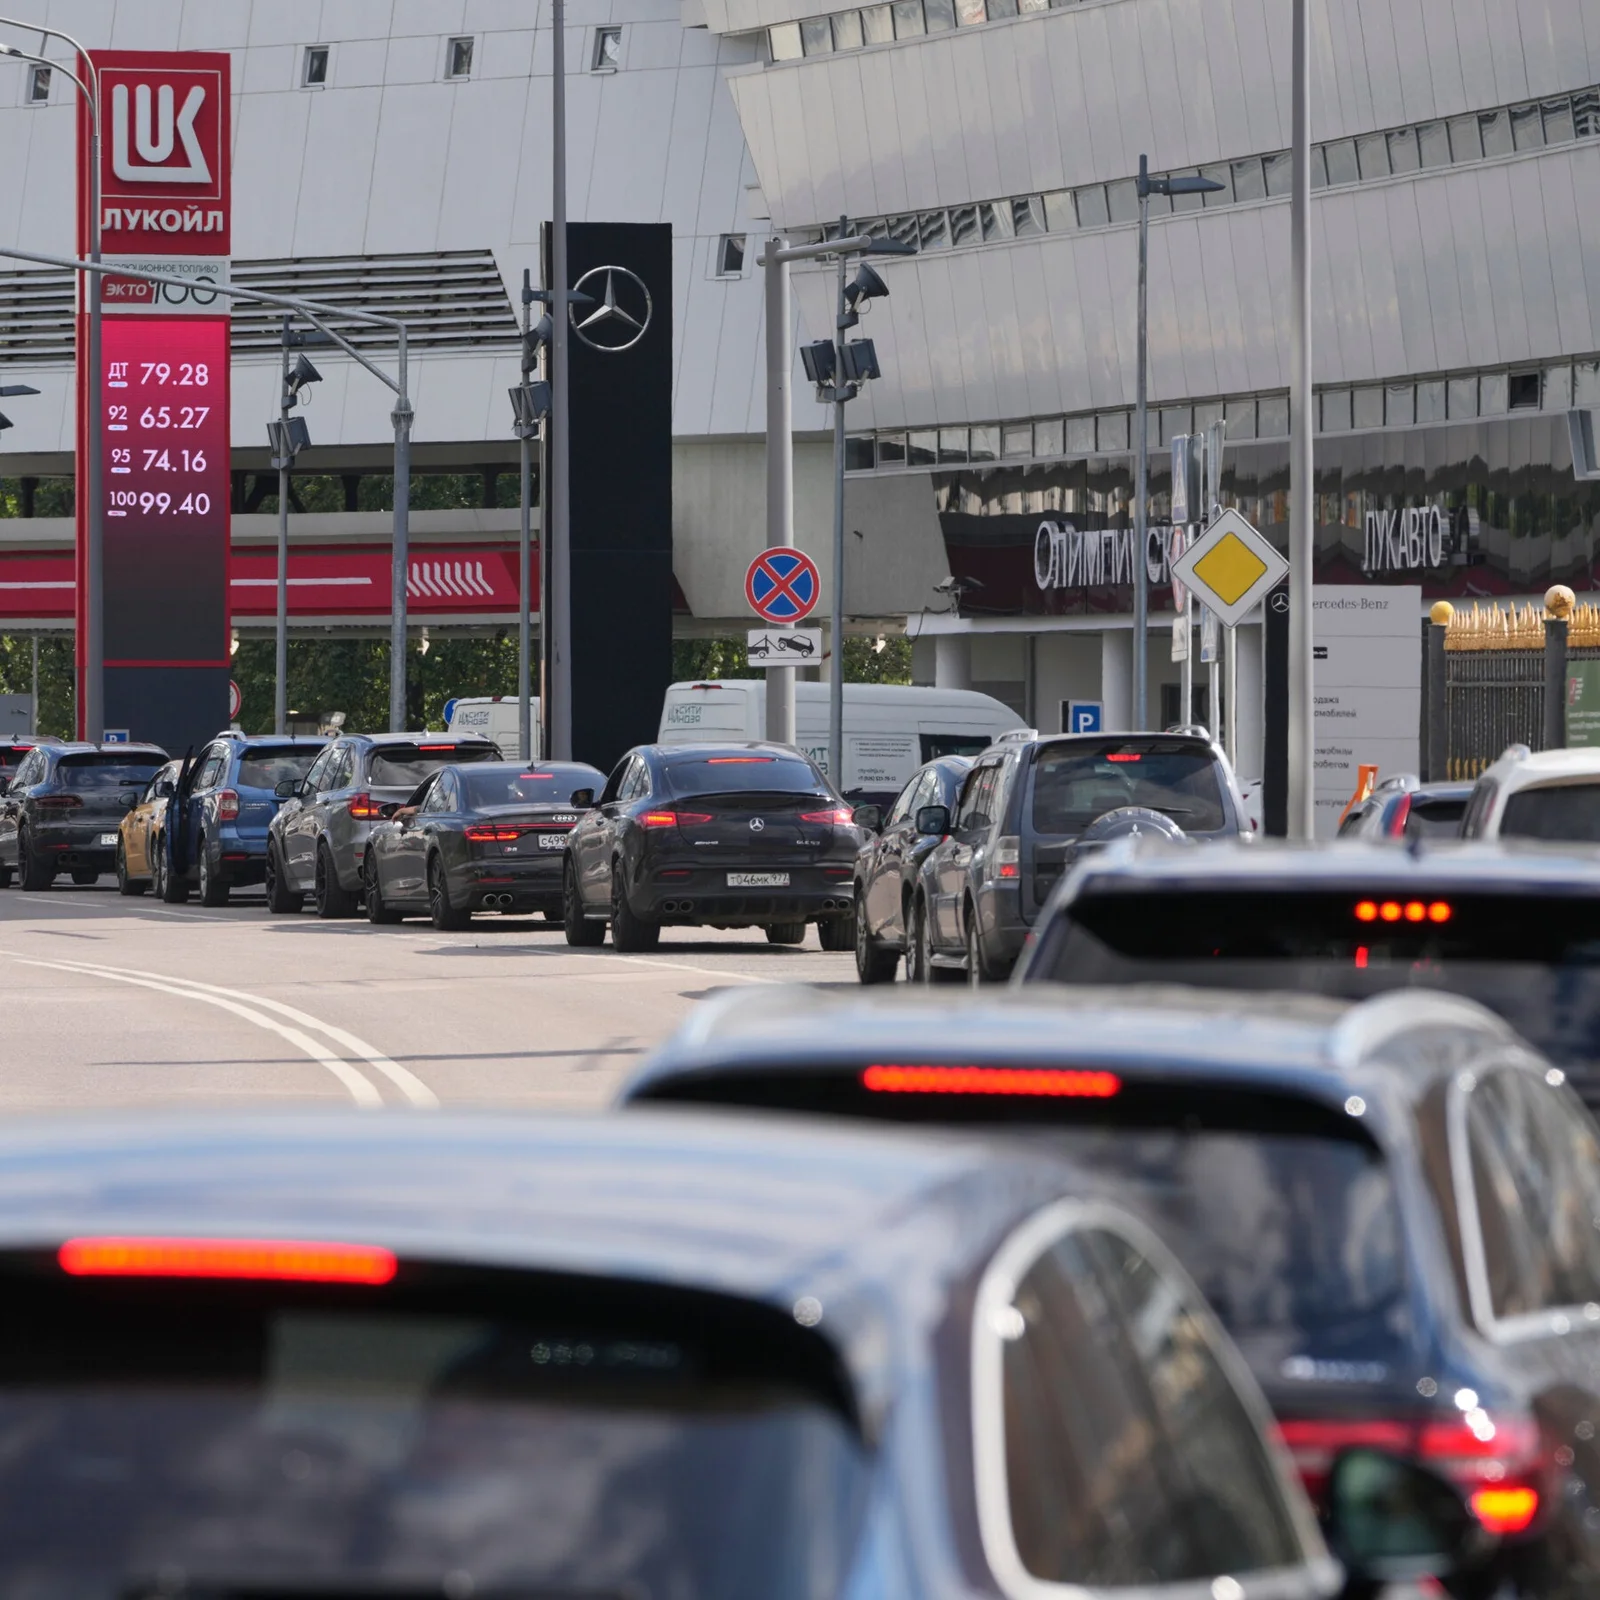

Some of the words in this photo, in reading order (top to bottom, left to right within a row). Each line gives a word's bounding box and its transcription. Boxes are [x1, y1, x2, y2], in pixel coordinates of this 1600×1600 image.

[101, 205, 224, 232] ЛУКОЙЛ
[104, 264, 176, 272] ЛЮЦИОННОЕ
[179, 264, 219, 274] ТОПЛИВО
[105, 284, 147, 296] ЭКТО
[148, 275, 218, 305] 100
[108, 362, 129, 379] ДТ
[140, 363, 209, 387] 79.28
[108, 405, 128, 420] 92
[139, 406, 210, 428] 65.27
[111, 449, 131, 463] 95
[142, 448, 207, 472] 74.16
[109, 491, 137, 506] 100
[139, 492, 210, 515] 99.40
[1363, 504, 1442, 571] ЛУКАВТО
[1312, 598, 1389, 610] ercedes-Benz
[1313, 696, 1339, 704] одажа
[1079, 713, 1094, 733] P
[1313, 709, 1357, 718] омобилей
[1313, 746, 1353, 756] омобили
[541, 835, 566, 846] С499
